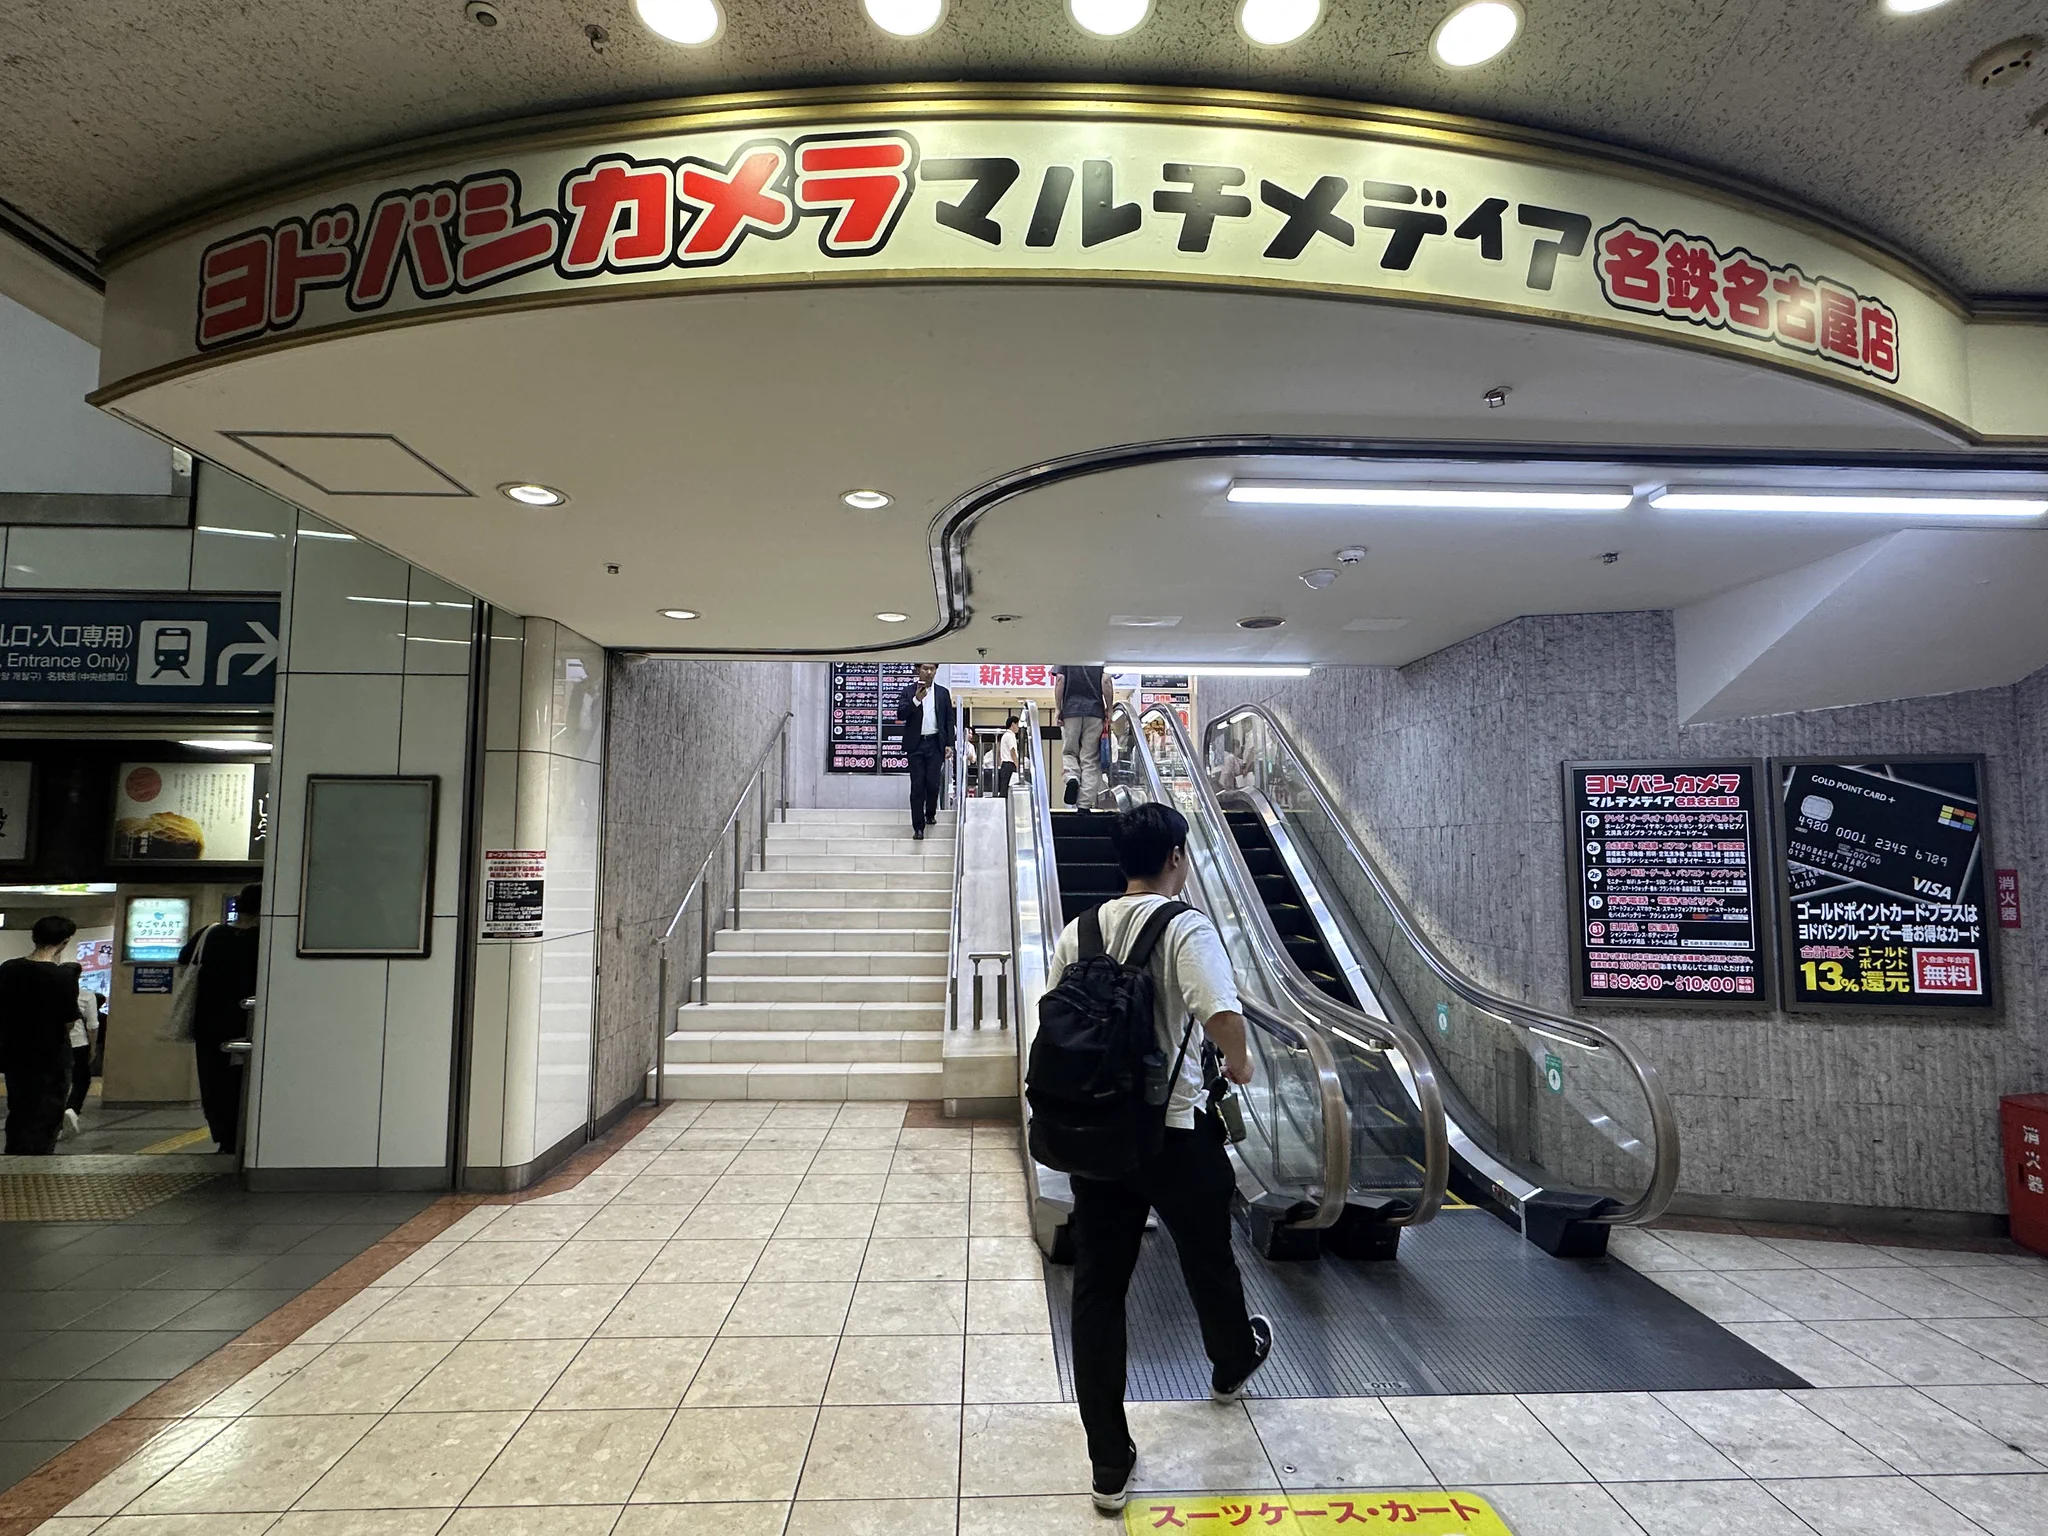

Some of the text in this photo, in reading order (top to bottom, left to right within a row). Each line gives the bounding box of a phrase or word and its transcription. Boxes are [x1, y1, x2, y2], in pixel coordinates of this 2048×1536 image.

[1594, 218, 1901, 385] 名鉄名古屋店
[8, 652, 130, 671] Entrance Only)
[850, 757, 875, 767] 9:30
[1585, 775, 1740, 794] ヨドバシカメラ
[1811, 774, 1835, 787] GOLD
[1836, 781, 1863, 795] POINT
[1864, 789, 1887, 801] CARD
[1587, 796, 1740, 807] マルチメディア 名鉄名古屋店
[1798, 815, 1829, 833] 4980
[1835, 827, 1867, 844] 0001
[1875, 838, 1908, 855] 2345
[1915, 851, 1948, 867] 6789
[1788, 848, 1854, 873] 012 345 6789
[1846, 857, 1868, 868] TARO
[1794, 879, 1817, 889] 6789
[1912, 876, 1952, 900] VISA
[1998, 875, 2018, 921] 消火器
[1797, 901, 1978, 922] ゴールドポイントカード・プラスは
[136, 921, 182, 929] なごやART
[1799, 924, 1980, 943] ヨドバシグループで一番お得なカード
[1800, 945, 1854, 959] 合計最大
[1858, 946, 1908, 957] ゴールド
[1859, 958, 1908, 969] ポイント
[1684, 976, 1735, 992] 10:00
[1800, 961, 1860, 992] 13%
[1861, 971, 1910, 992] 還元
[1923, 965, 1972, 987] 無料
[2022, 1124, 2044, 1194] 消火器
[1150, 1498, 1480, 1528] スーツケース・カート
